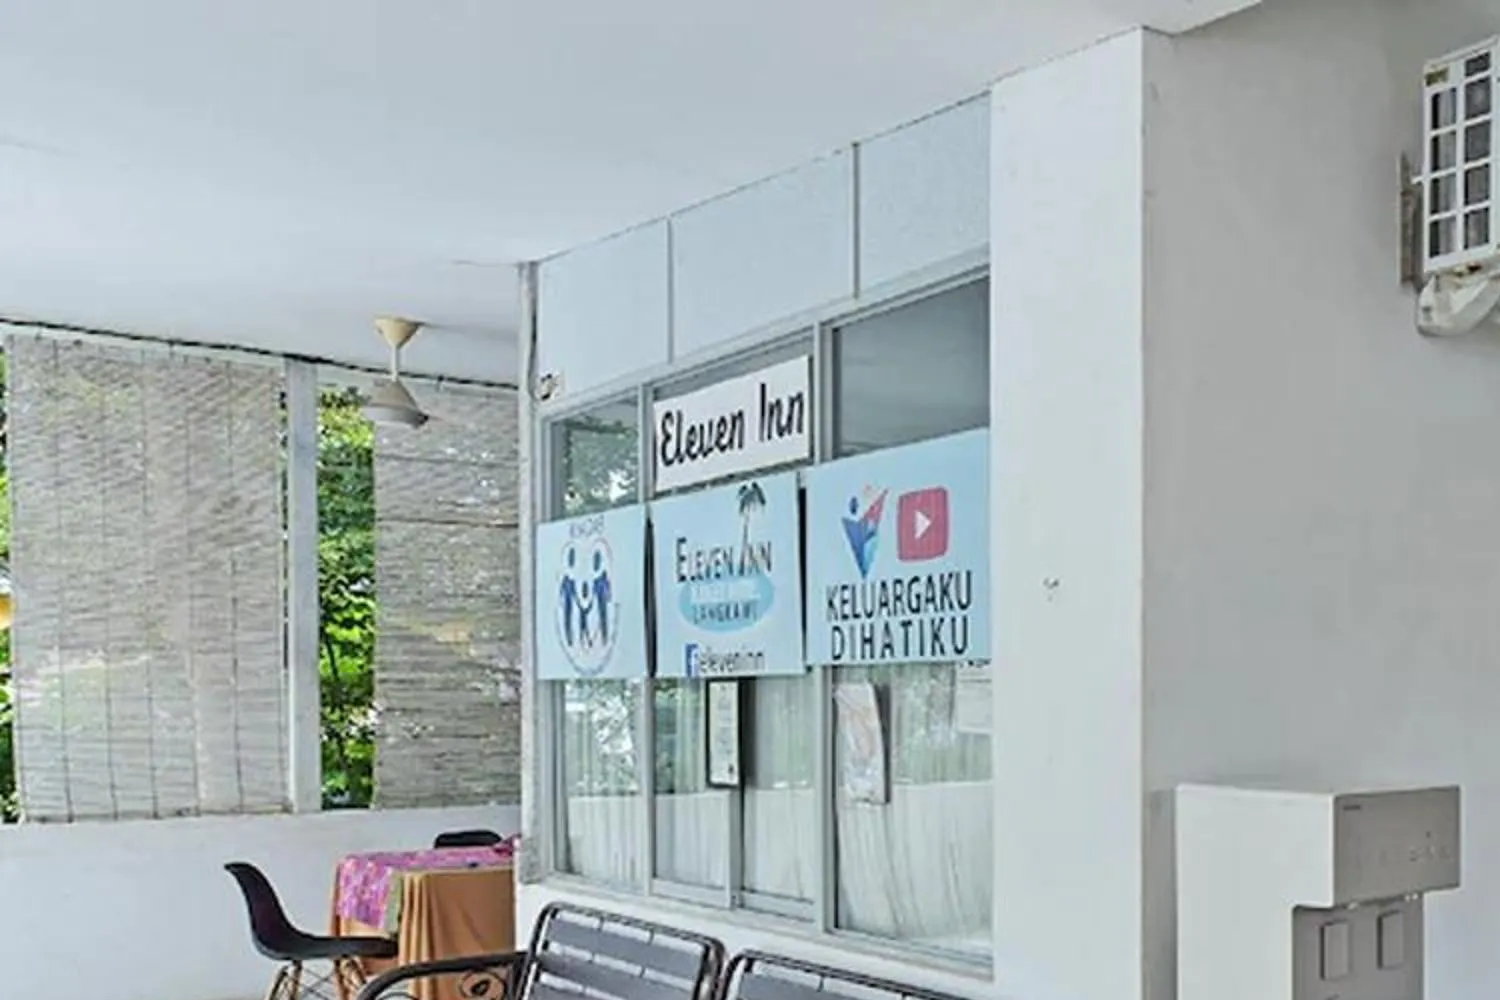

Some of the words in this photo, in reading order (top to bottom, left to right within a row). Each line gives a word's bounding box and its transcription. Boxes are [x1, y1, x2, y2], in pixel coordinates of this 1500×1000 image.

[661, 410, 745, 467] Eleven
[758, 382, 805, 443] Inn
[825, 569, 973, 622] KELUARGAKU
[831, 615, 969, 661] DIHATIKU
